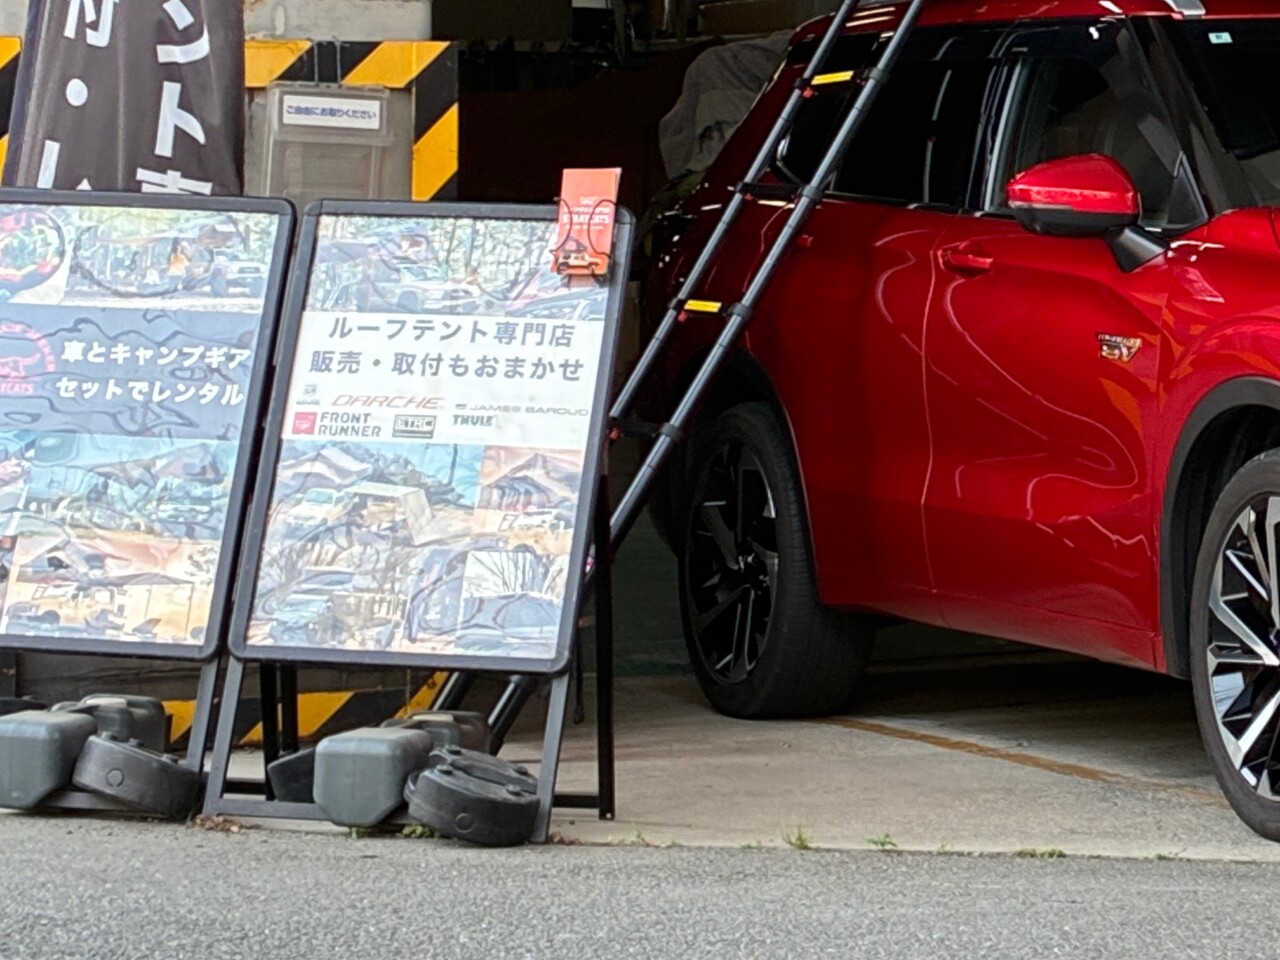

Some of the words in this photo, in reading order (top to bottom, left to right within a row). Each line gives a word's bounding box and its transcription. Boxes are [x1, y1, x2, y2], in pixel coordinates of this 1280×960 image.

[329, 317, 576, 349] ルーフテント専門店
[61, 341, 252, 370] 車とキャンプギア
[309, 350, 585, 382] 販売・取付もおまかせ
[56, 376, 244, 406] セットでレンタル
[331, 394, 443, 410] DARCHE
[469, 404, 521, 414] JAMES
[320, 411, 372, 424] FRONT
[453, 414, 494, 427] THULE
[318, 424, 382, 438] RUNNER
